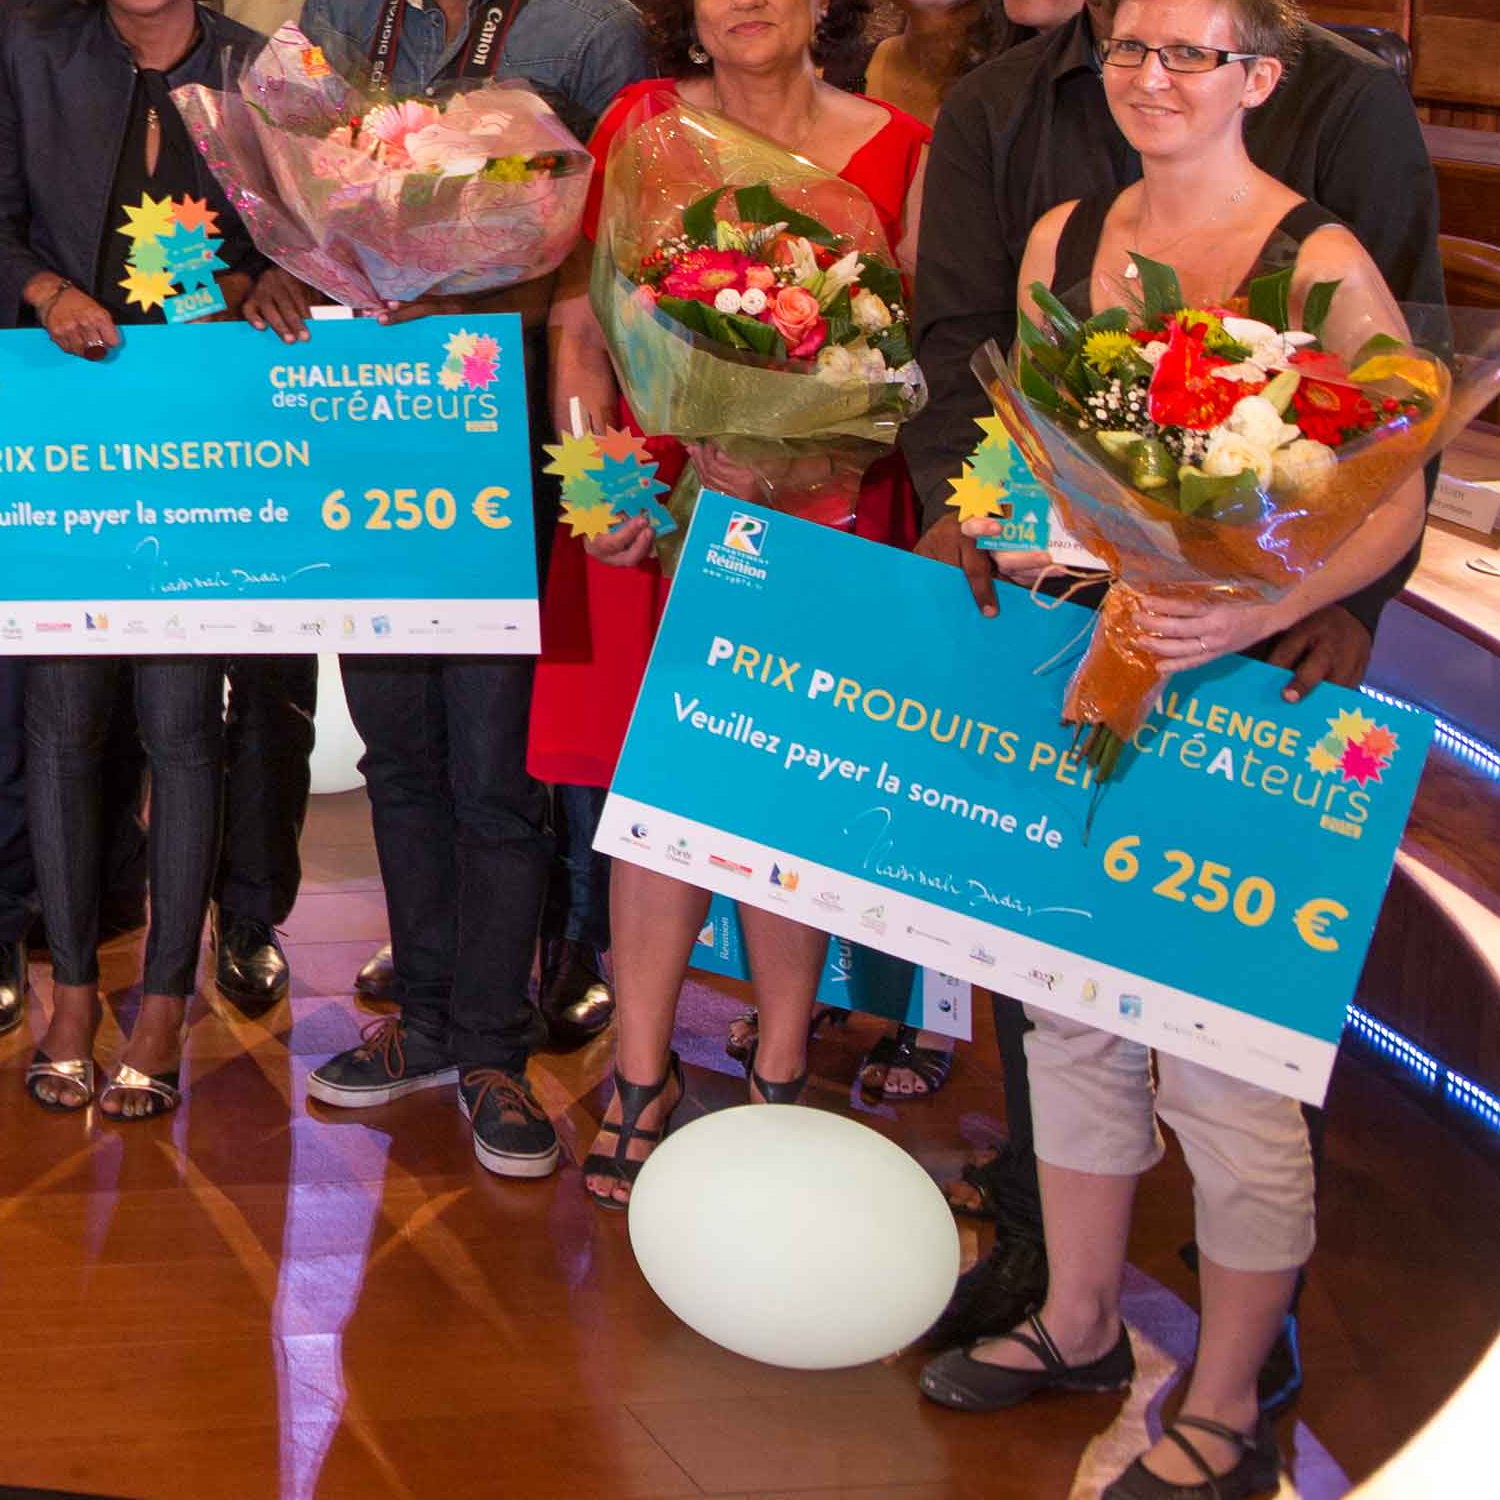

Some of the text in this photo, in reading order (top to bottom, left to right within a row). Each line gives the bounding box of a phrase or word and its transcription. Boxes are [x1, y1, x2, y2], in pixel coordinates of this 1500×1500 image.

[472, 7, 503, 66] Canon
[269, 362, 431, 389] CHALLENGE
[271, 389, 499, 422] des créAteurs
[45, 444, 90, 472] DE
[100, 440, 310, 472] L'INSERTION
[63, 507, 131, 534] payer
[136, 500, 157, 524] la
[164, 507, 252, 525] somme
[259, 499, 289, 523] de
[321, 489, 351, 531] 6
[364, 487, 457, 530] 250
[471, 486, 512, 529] €
[1002, 520, 1037, 542] 014
[706, 549, 767, 580] Réunion
[706, 636, 802, 693] PRIX
[807, 668, 1020, 765] PRODUITS
[1153, 691, 1302, 757] LLENGE
[1131, 723, 1371, 824] créAteurs
[673, 693, 1349, 952] Veuillez payer la somme de 6 250 €
